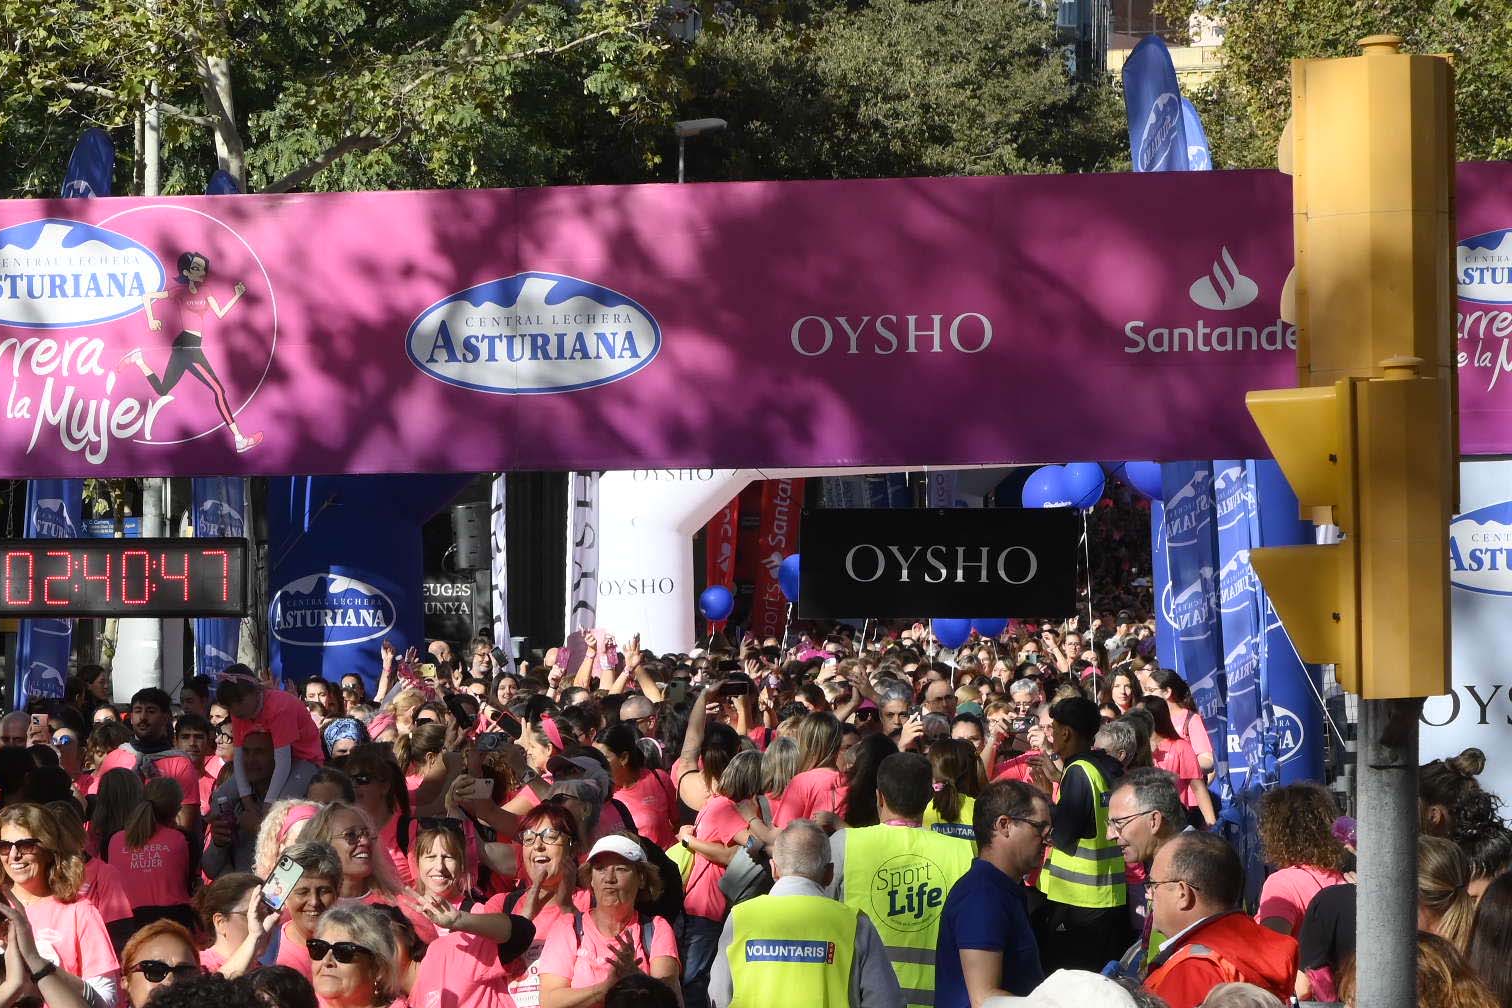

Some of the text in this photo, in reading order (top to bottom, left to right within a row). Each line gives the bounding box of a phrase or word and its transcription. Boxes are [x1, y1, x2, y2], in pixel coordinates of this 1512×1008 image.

[68, 256, 141, 267] LECHERA
[465, 312, 633, 328] CENTRAL LECHERA
[790, 312, 994, 356] OYSHO
[1123, 319, 1297, 353] Santande
[425, 319, 641, 363] ASTURIANA
[6, 381, 31, 420] la
[26, 372, 175, 465] Mujer
[5, 550, 230, 605] 02:40:47
[844, 544, 1038, 585] OYSHO
[598, 576, 675, 597] OYSHO
[274, 602, 387, 631] ASTURIANA
[130, 859, 163, 869] MUJER
[131, 853, 145, 861] DE
[877, 861, 932, 891] Sport
[887, 882, 942, 920] Life
[746, 945, 825, 958] VOLUNTARIS
